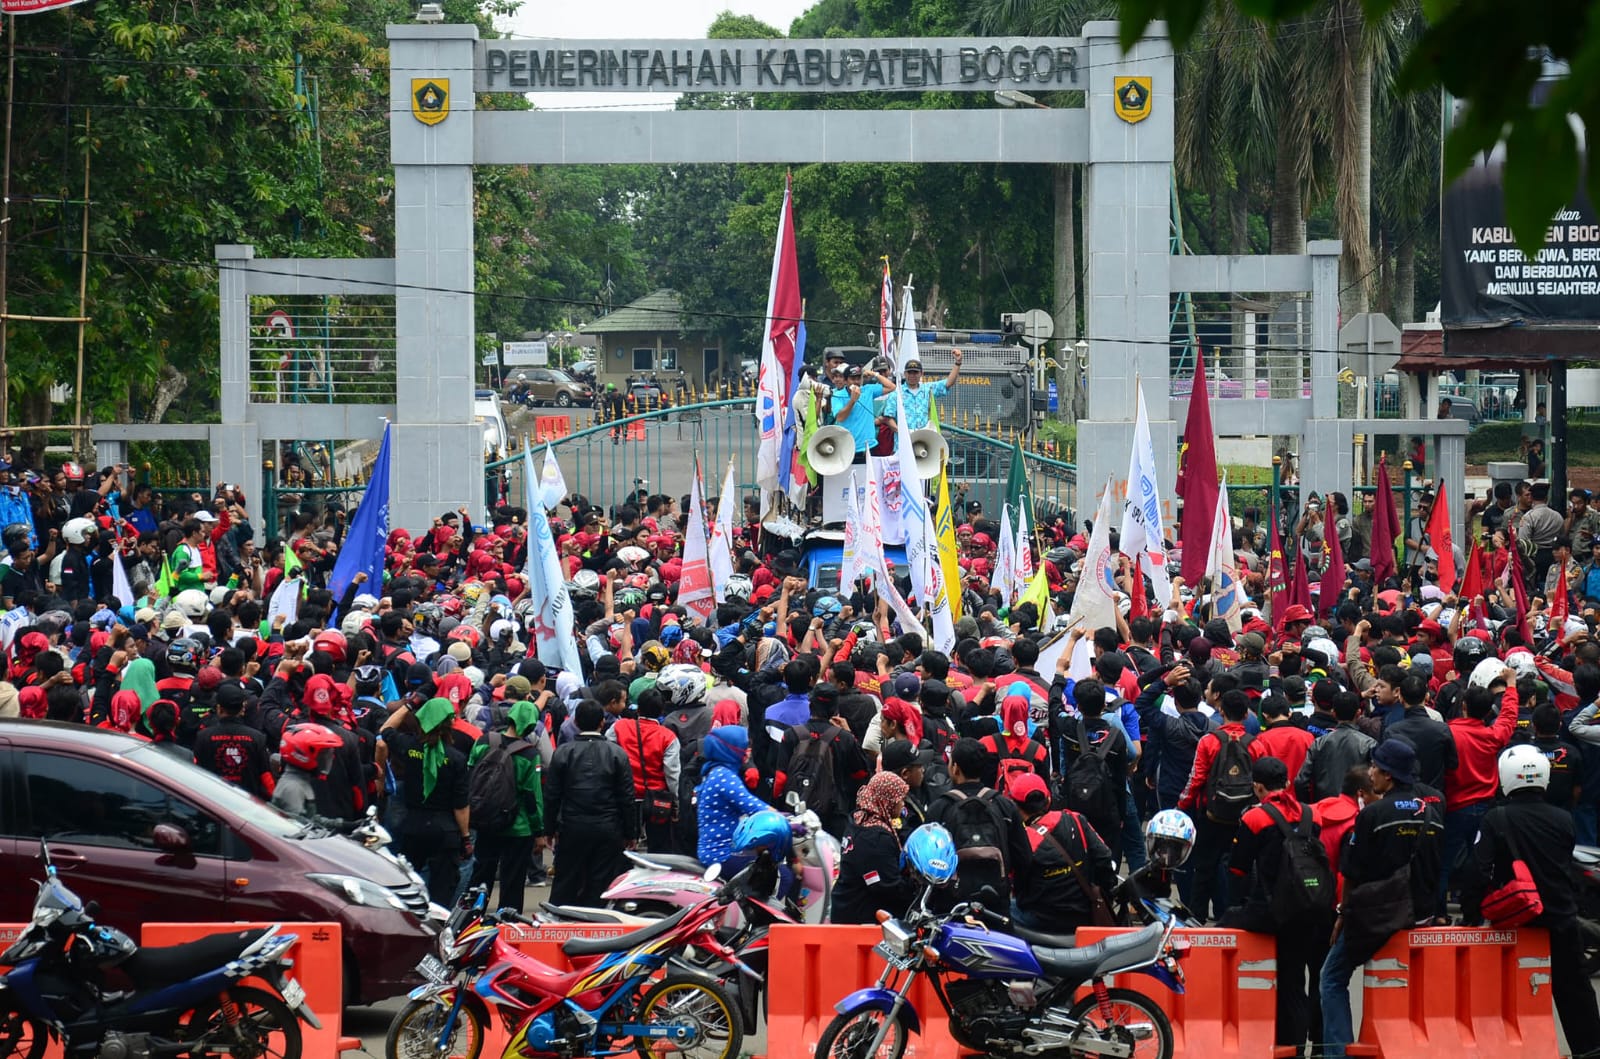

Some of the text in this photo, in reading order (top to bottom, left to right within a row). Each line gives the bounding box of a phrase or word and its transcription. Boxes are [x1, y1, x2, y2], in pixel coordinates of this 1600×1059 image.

[486, 45, 1078, 87] PEMERINTAHAN KABUPATEN BOGOR
[1472, 225, 1564, 244] KABUEN
[1464, 249, 1496, 263] YANG
[1499, 248, 1570, 263] BERTQWA,
[1495, 264, 1598, 279] DAN BERBUDAYA
[1486, 282, 1534, 295] MENUJU
[1201, 935, 1232, 946] JABAR
[1413, 932, 1513, 944] DISHUB PROVINSI JABAR
